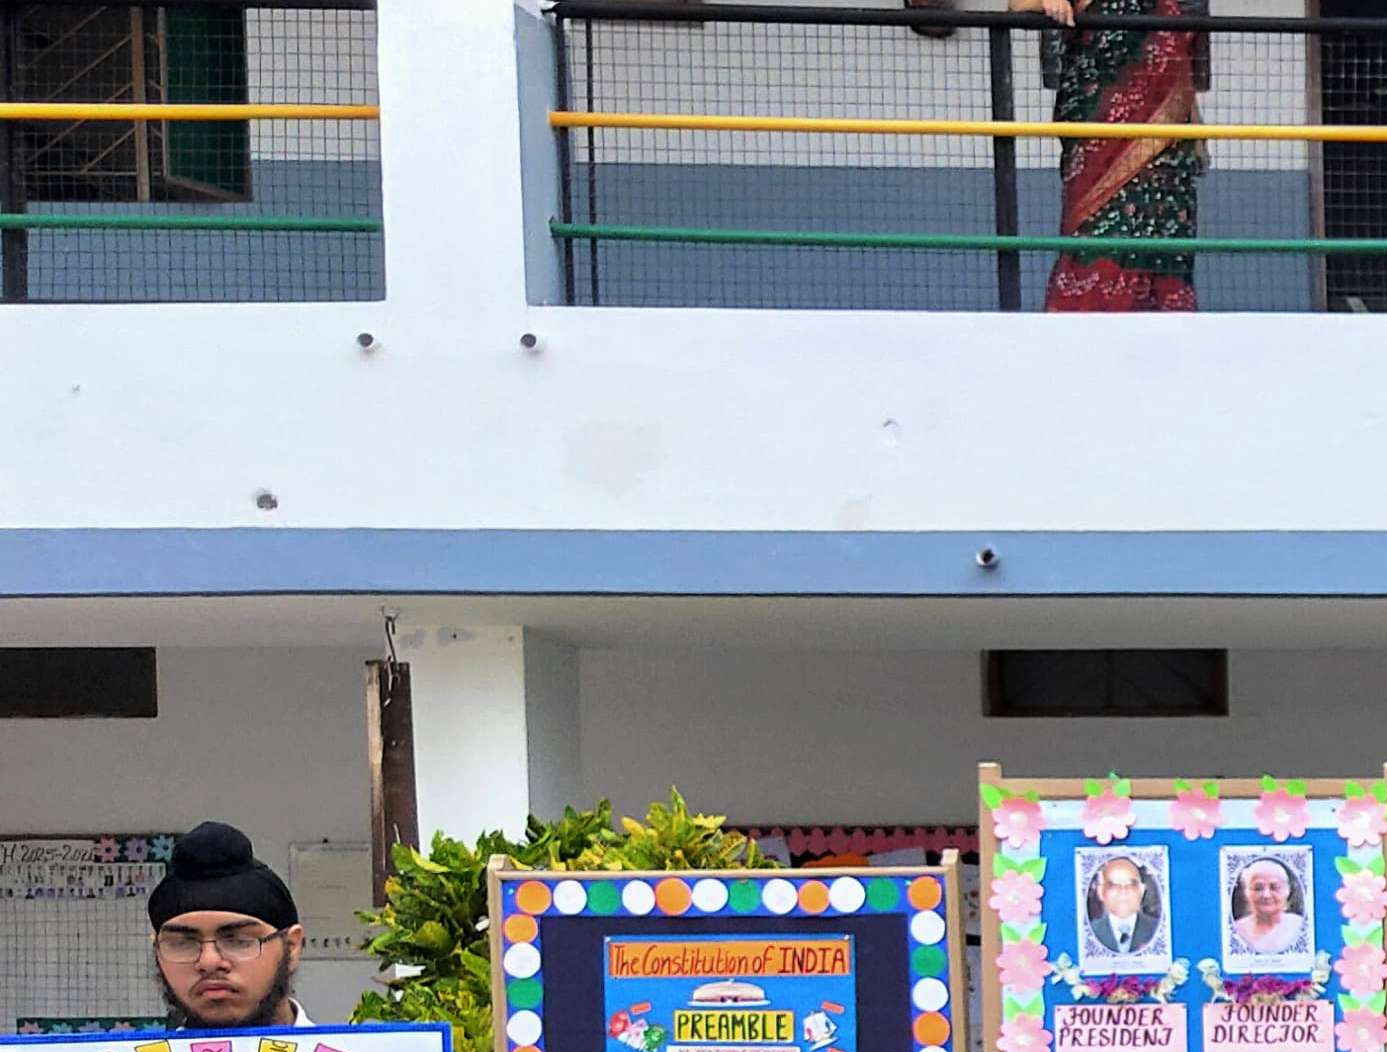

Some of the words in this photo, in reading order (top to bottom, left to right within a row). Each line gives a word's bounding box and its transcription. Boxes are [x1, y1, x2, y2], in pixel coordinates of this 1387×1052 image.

[614, 944, 643, 976] The
[641, 944, 749, 977] Constitution
[751, 943, 773, 975] of
[777, 945, 846, 975] INDIA
[676, 1012, 788, 1041] PREAMBLE
